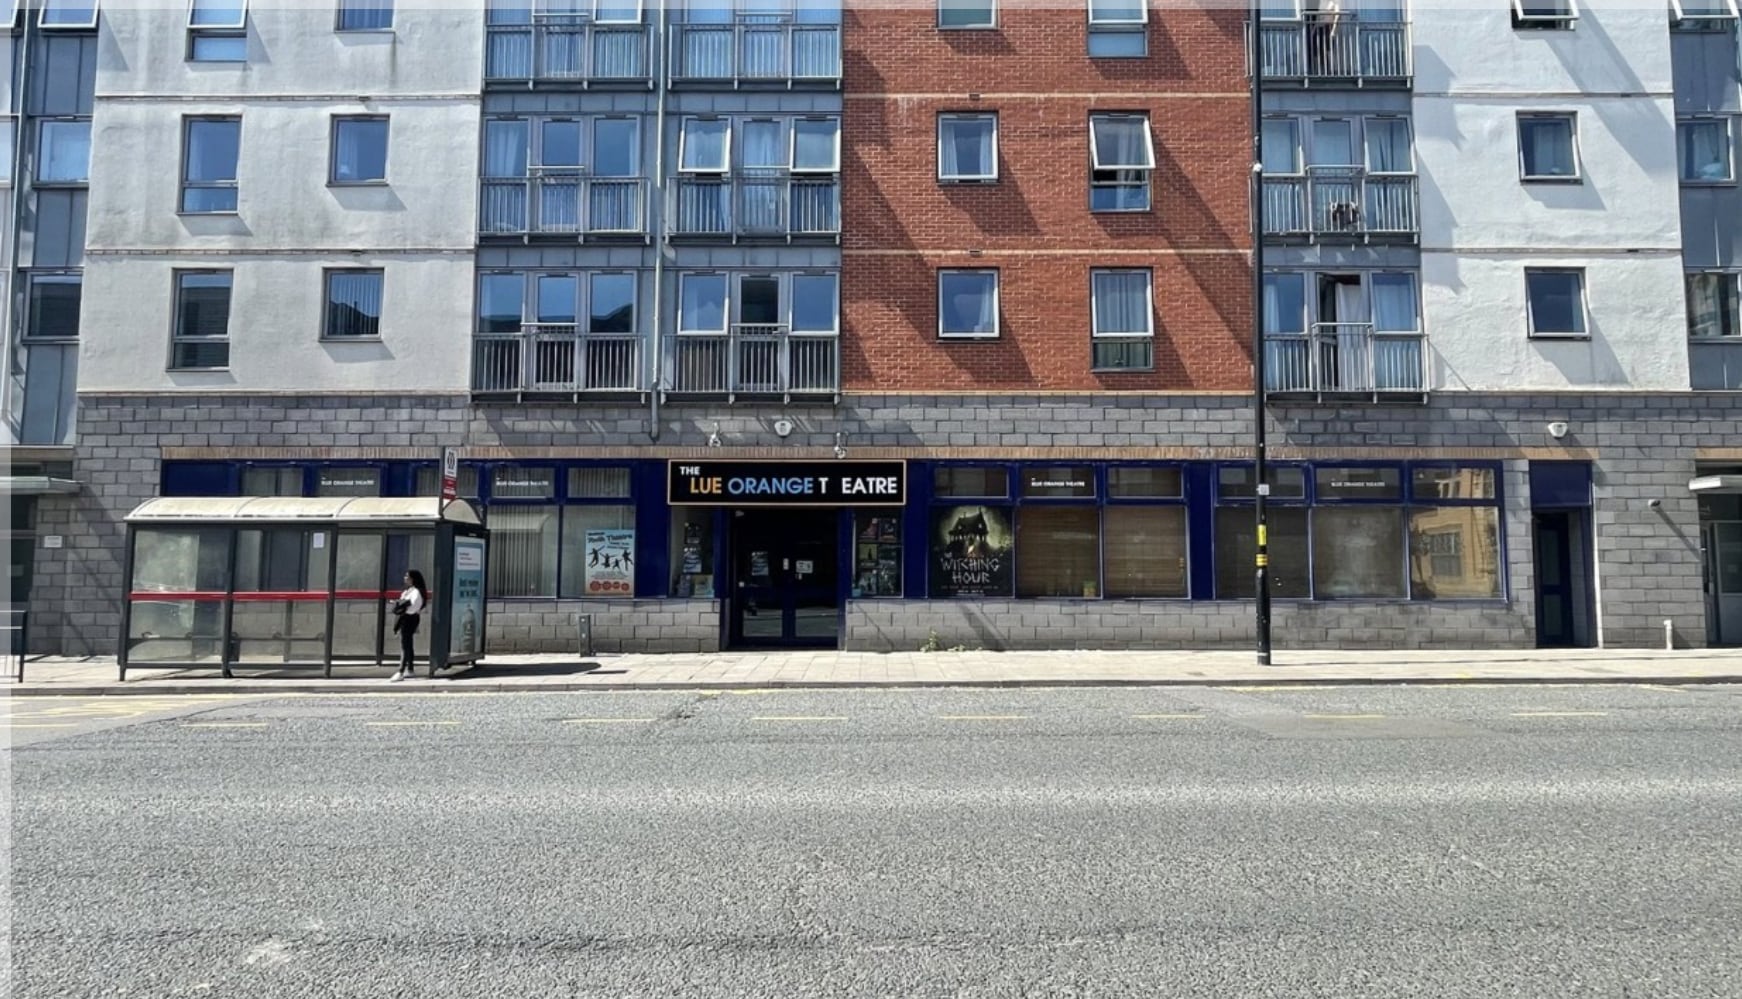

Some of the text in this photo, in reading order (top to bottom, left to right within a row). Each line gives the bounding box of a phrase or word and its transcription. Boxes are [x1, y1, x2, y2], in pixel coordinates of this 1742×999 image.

[680, 466, 700, 475] THE
[728, 477, 814, 494] ORANGE
[940, 558, 1000, 572] WITCHING
[952, 571, 990, 584] HOUR
